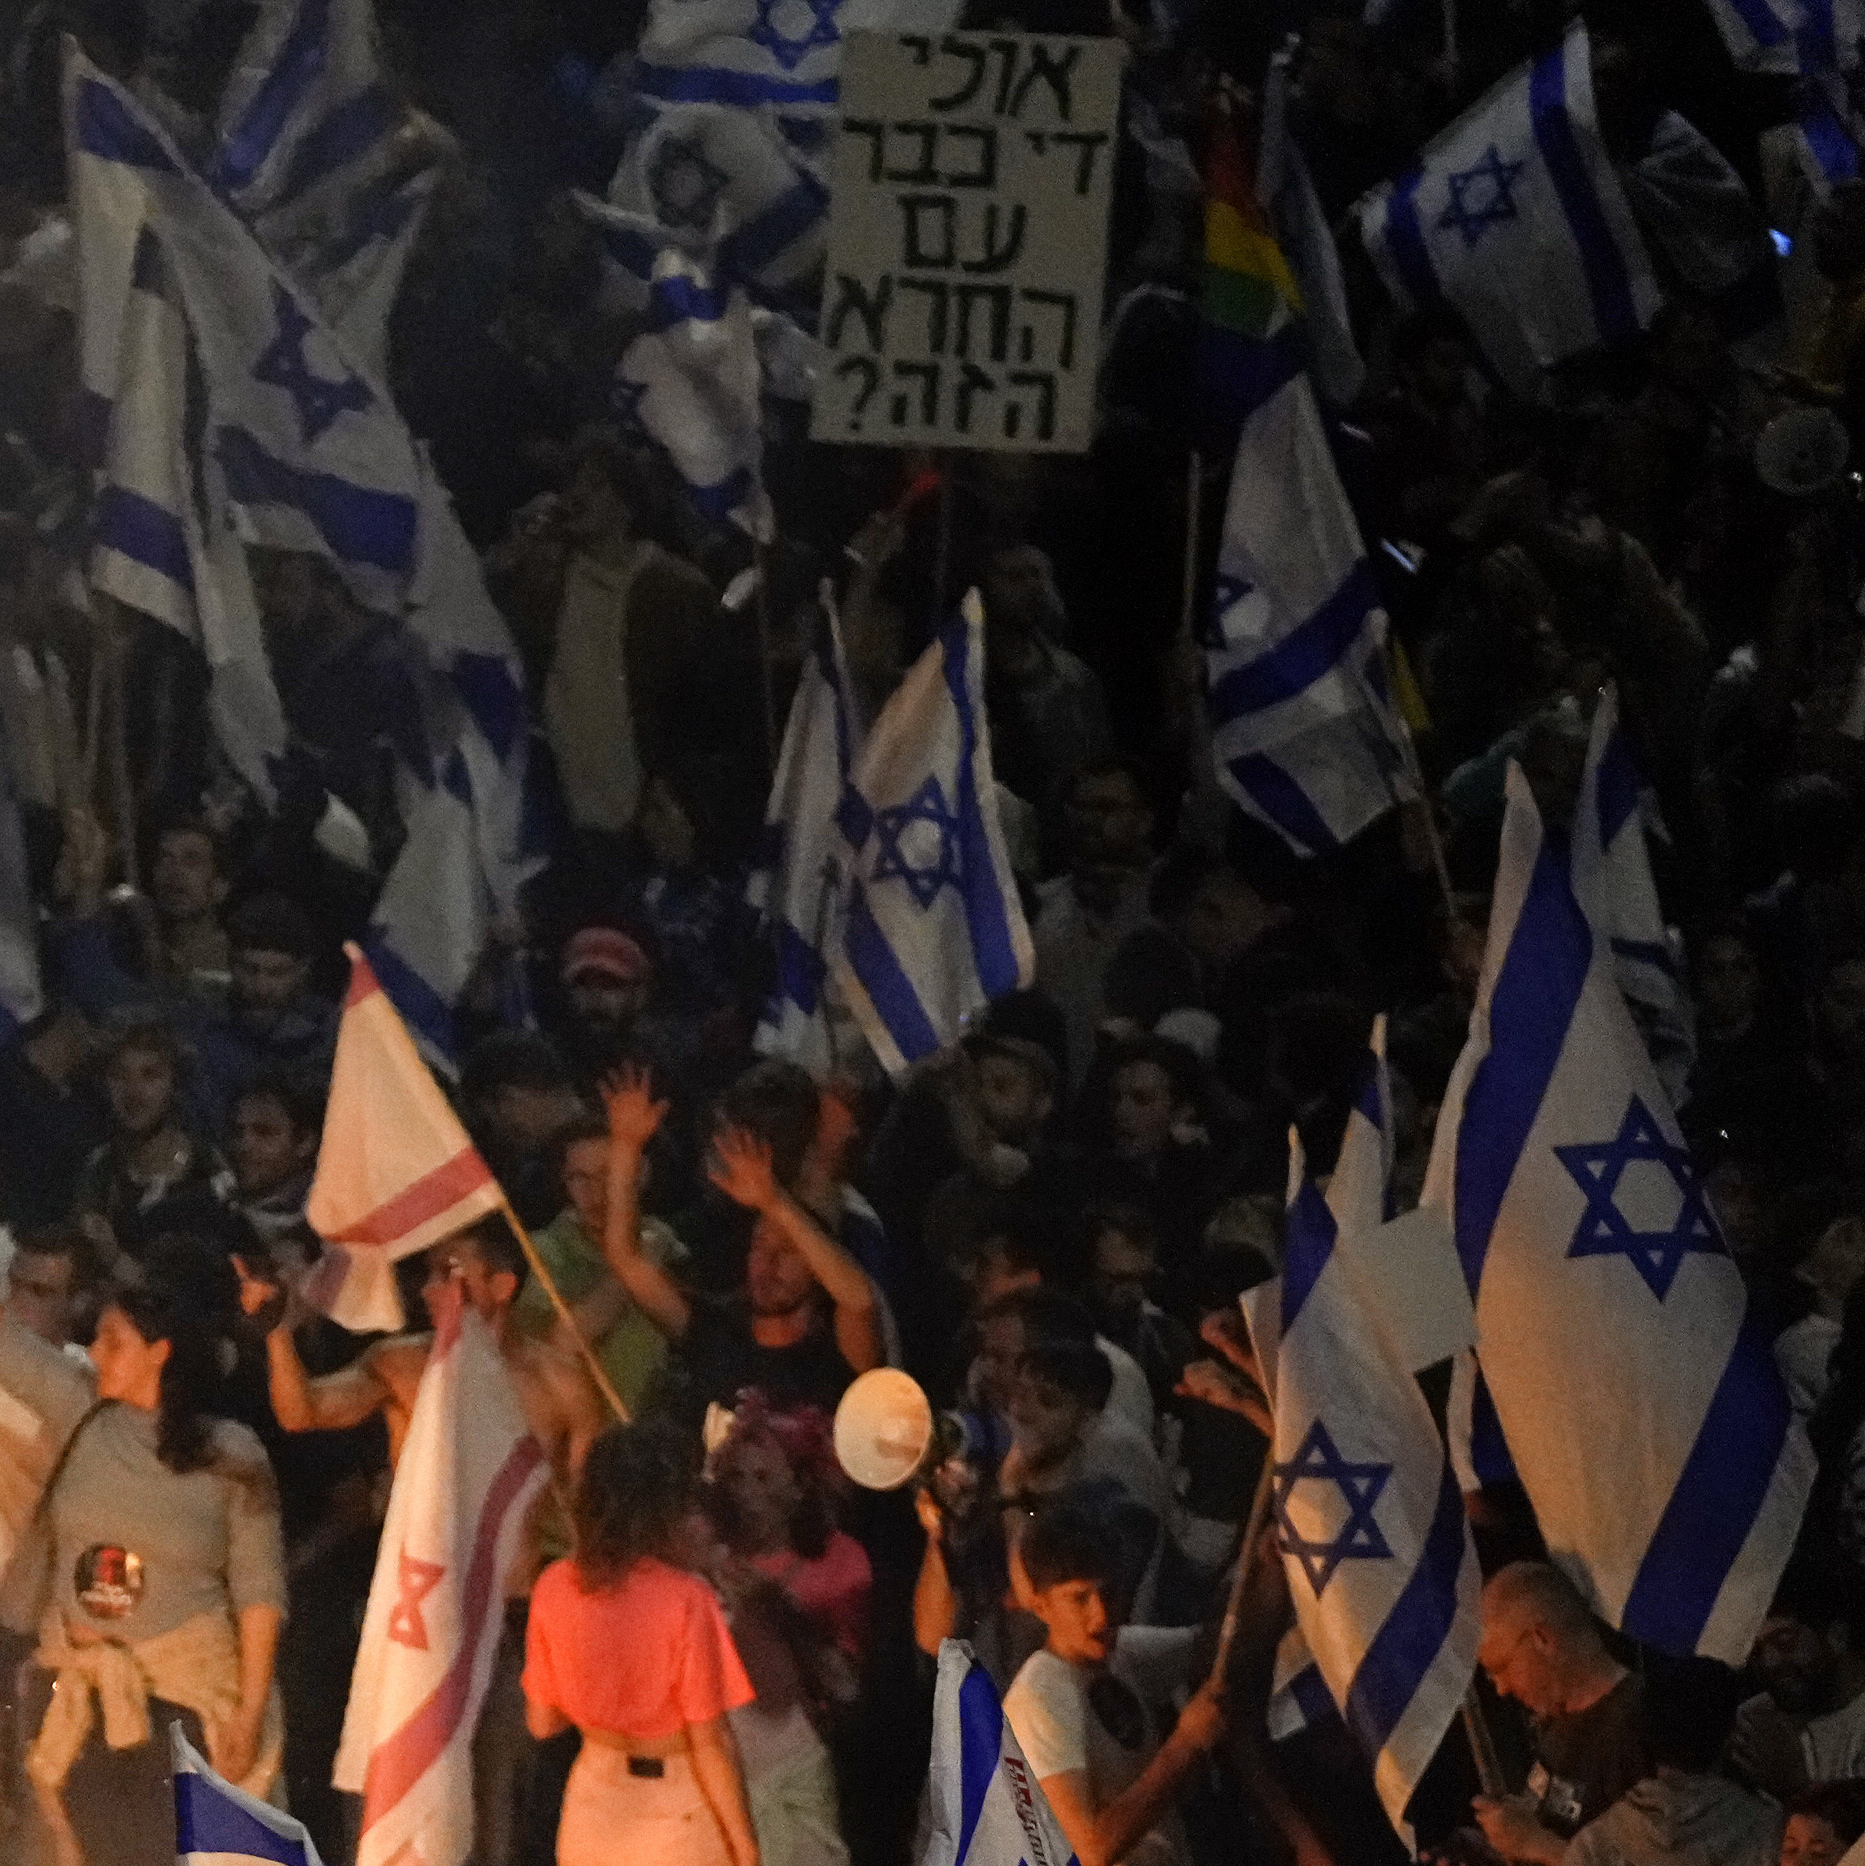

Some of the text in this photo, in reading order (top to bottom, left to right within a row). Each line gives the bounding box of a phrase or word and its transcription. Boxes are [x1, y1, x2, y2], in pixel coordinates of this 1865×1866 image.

[900, 34, 1082, 119] אולי
[842, 118, 1110, 195] די כבר
[896, 195, 1027, 272] עם
[825, 274, 1077, 371] החרא
[834, 355, 1056, 441] הזה?
